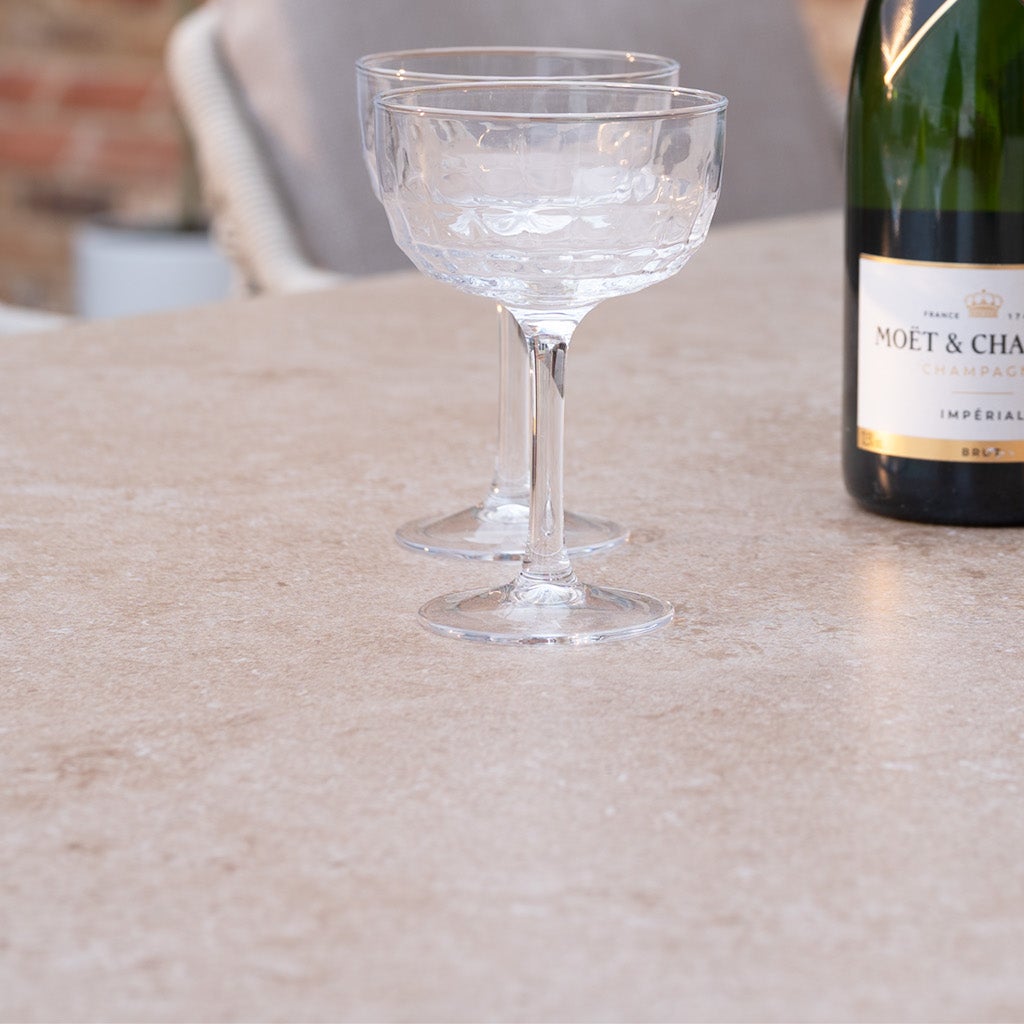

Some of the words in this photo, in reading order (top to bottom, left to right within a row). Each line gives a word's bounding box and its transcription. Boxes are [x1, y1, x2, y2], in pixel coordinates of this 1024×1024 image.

[922, 309, 960, 321] FRANCE
[875, 325, 939, 353] MOËT
[944, 332, 964, 355] &
